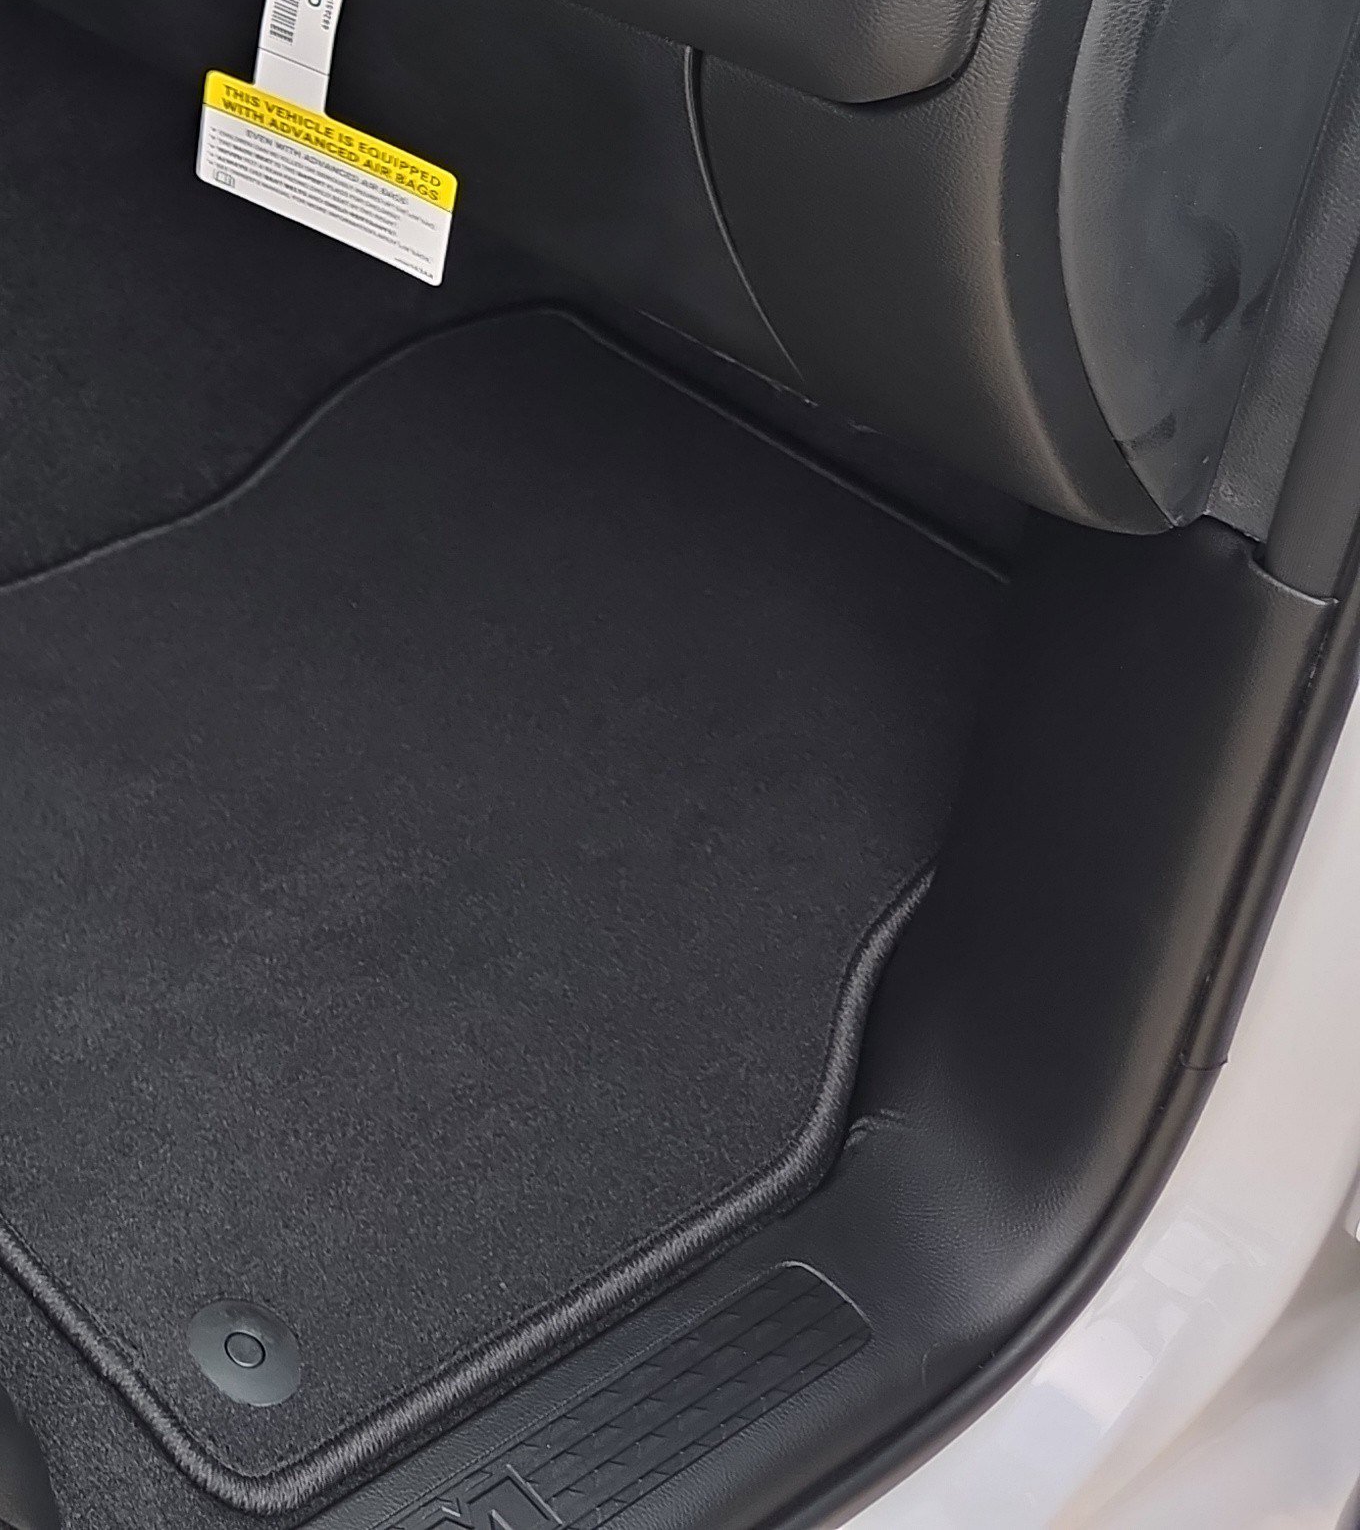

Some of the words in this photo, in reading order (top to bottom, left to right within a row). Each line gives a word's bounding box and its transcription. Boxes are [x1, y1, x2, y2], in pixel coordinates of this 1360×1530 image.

[221, 97, 265, 123] WITH
[269, 119, 360, 163] ADVANCED
[362, 158, 393, 180] AIR
[394, 172, 440, 202] BAGS
[224, 84, 260, 108] THIS
[264, 100, 335, 139] VEHICLE
[337, 127, 355, 147] IS
[358, 135, 442, 188] EQUIPPED
[273, 138, 302, 159] WITH
[304, 148, 360, 183] ADVANCED
[361, 173, 380, 192] AIR
